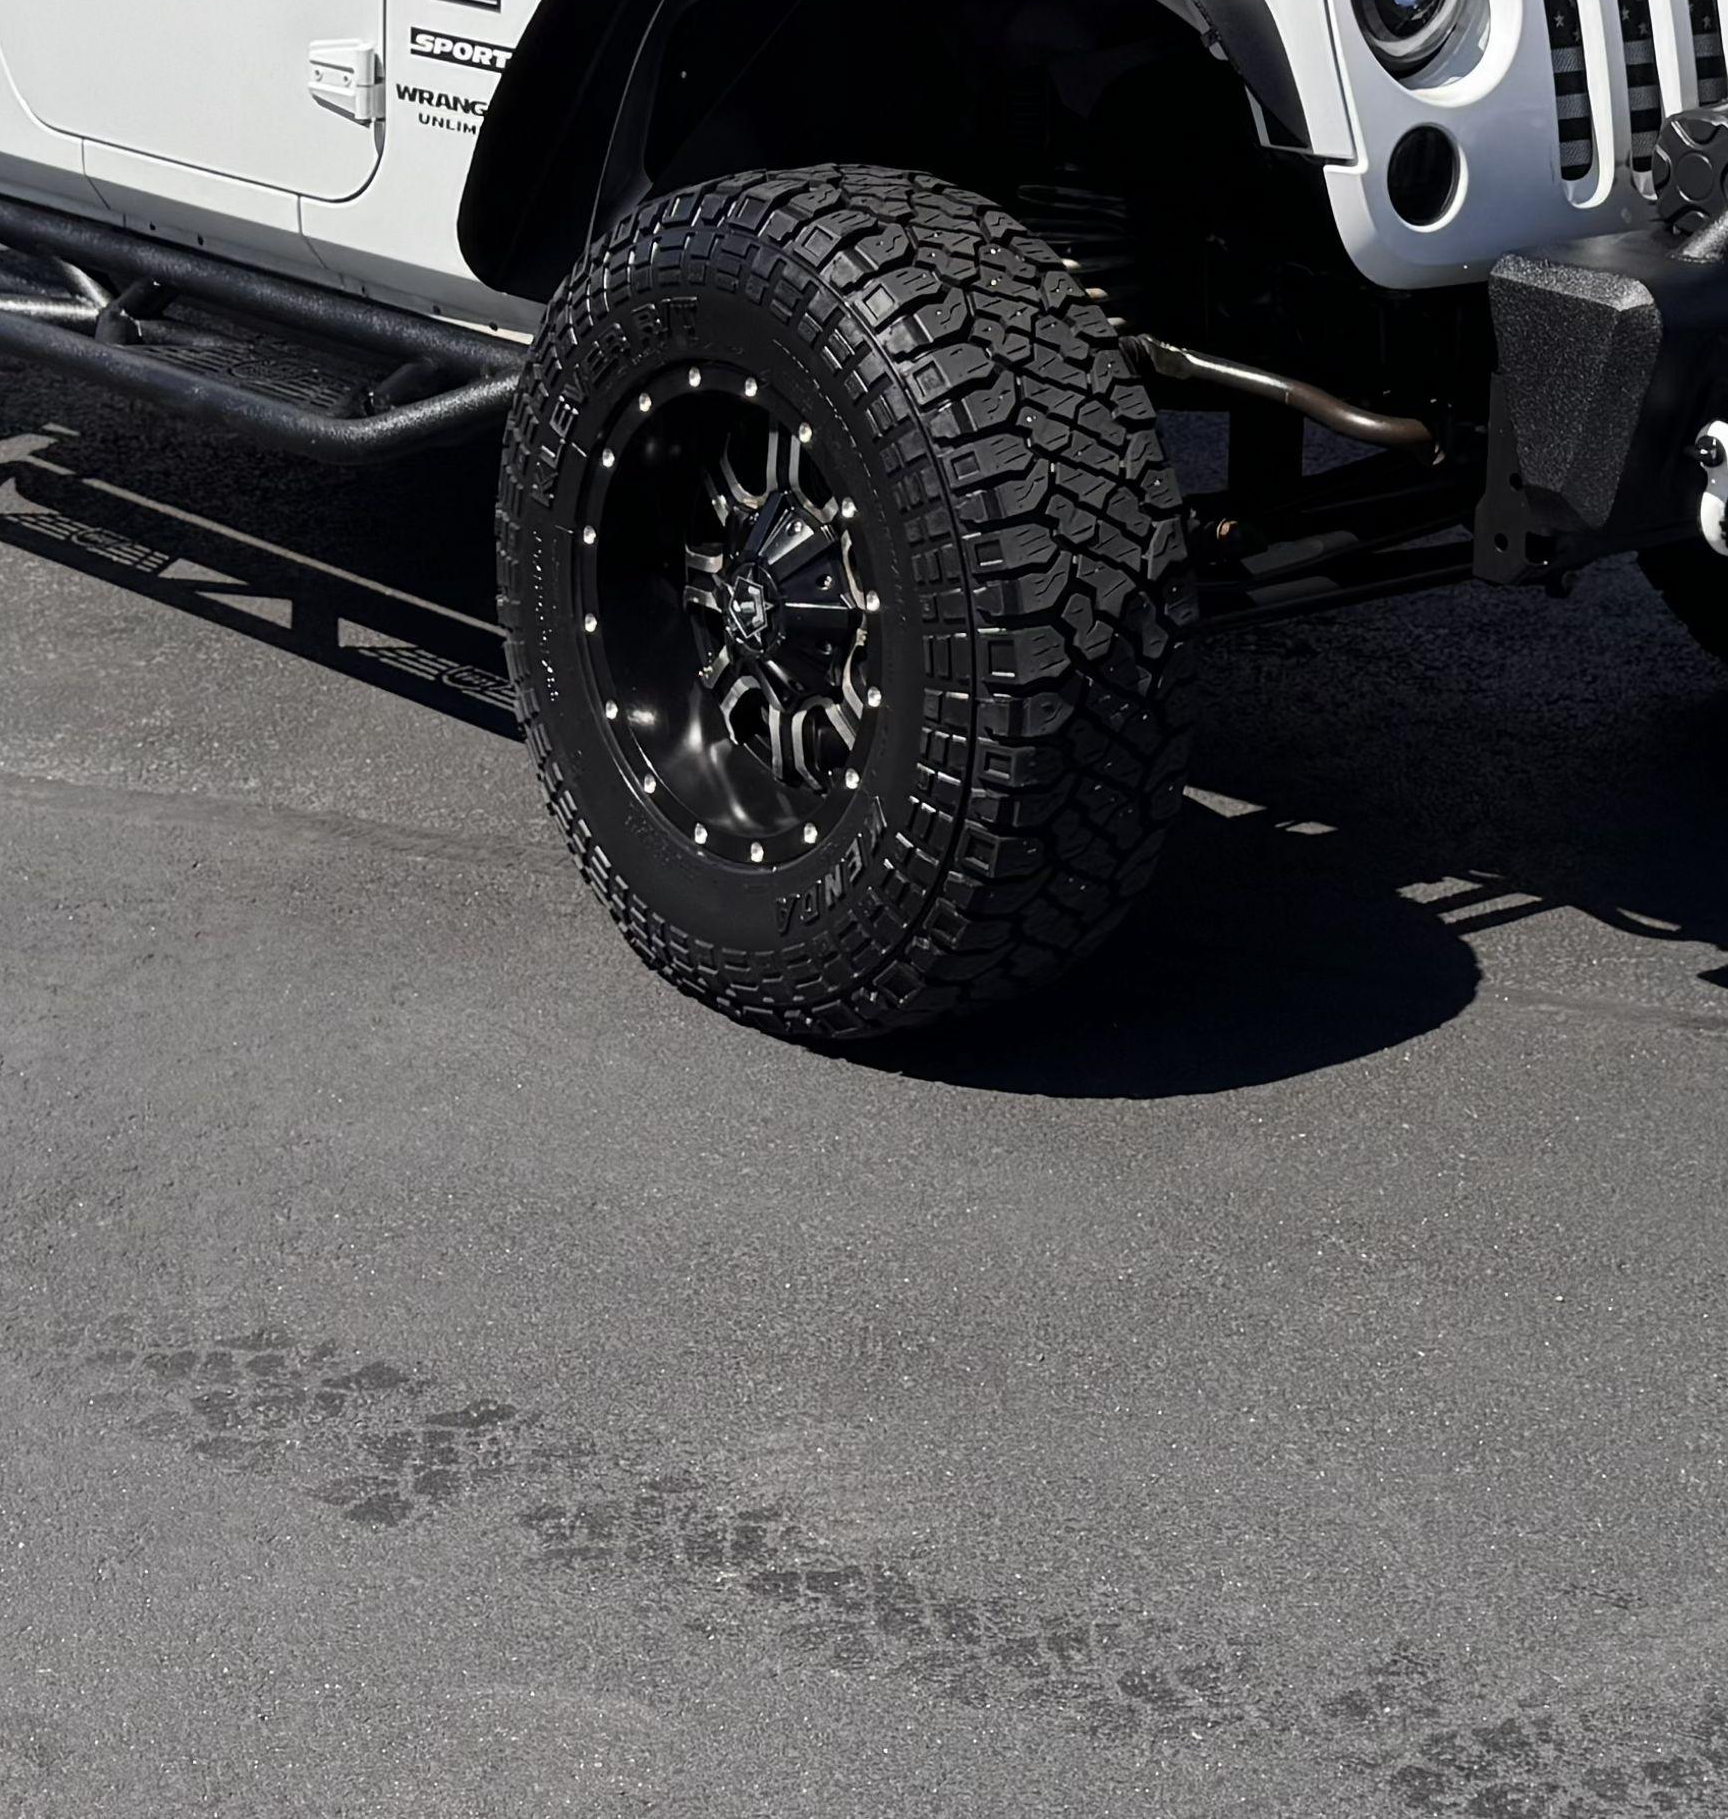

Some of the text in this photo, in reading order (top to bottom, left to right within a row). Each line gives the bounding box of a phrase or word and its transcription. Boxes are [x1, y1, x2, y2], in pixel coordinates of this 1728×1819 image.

[415, 33, 513, 69] SPORT
[396, 83, 489, 117] WRANG
[419, 112, 478, 135] UNLIM
